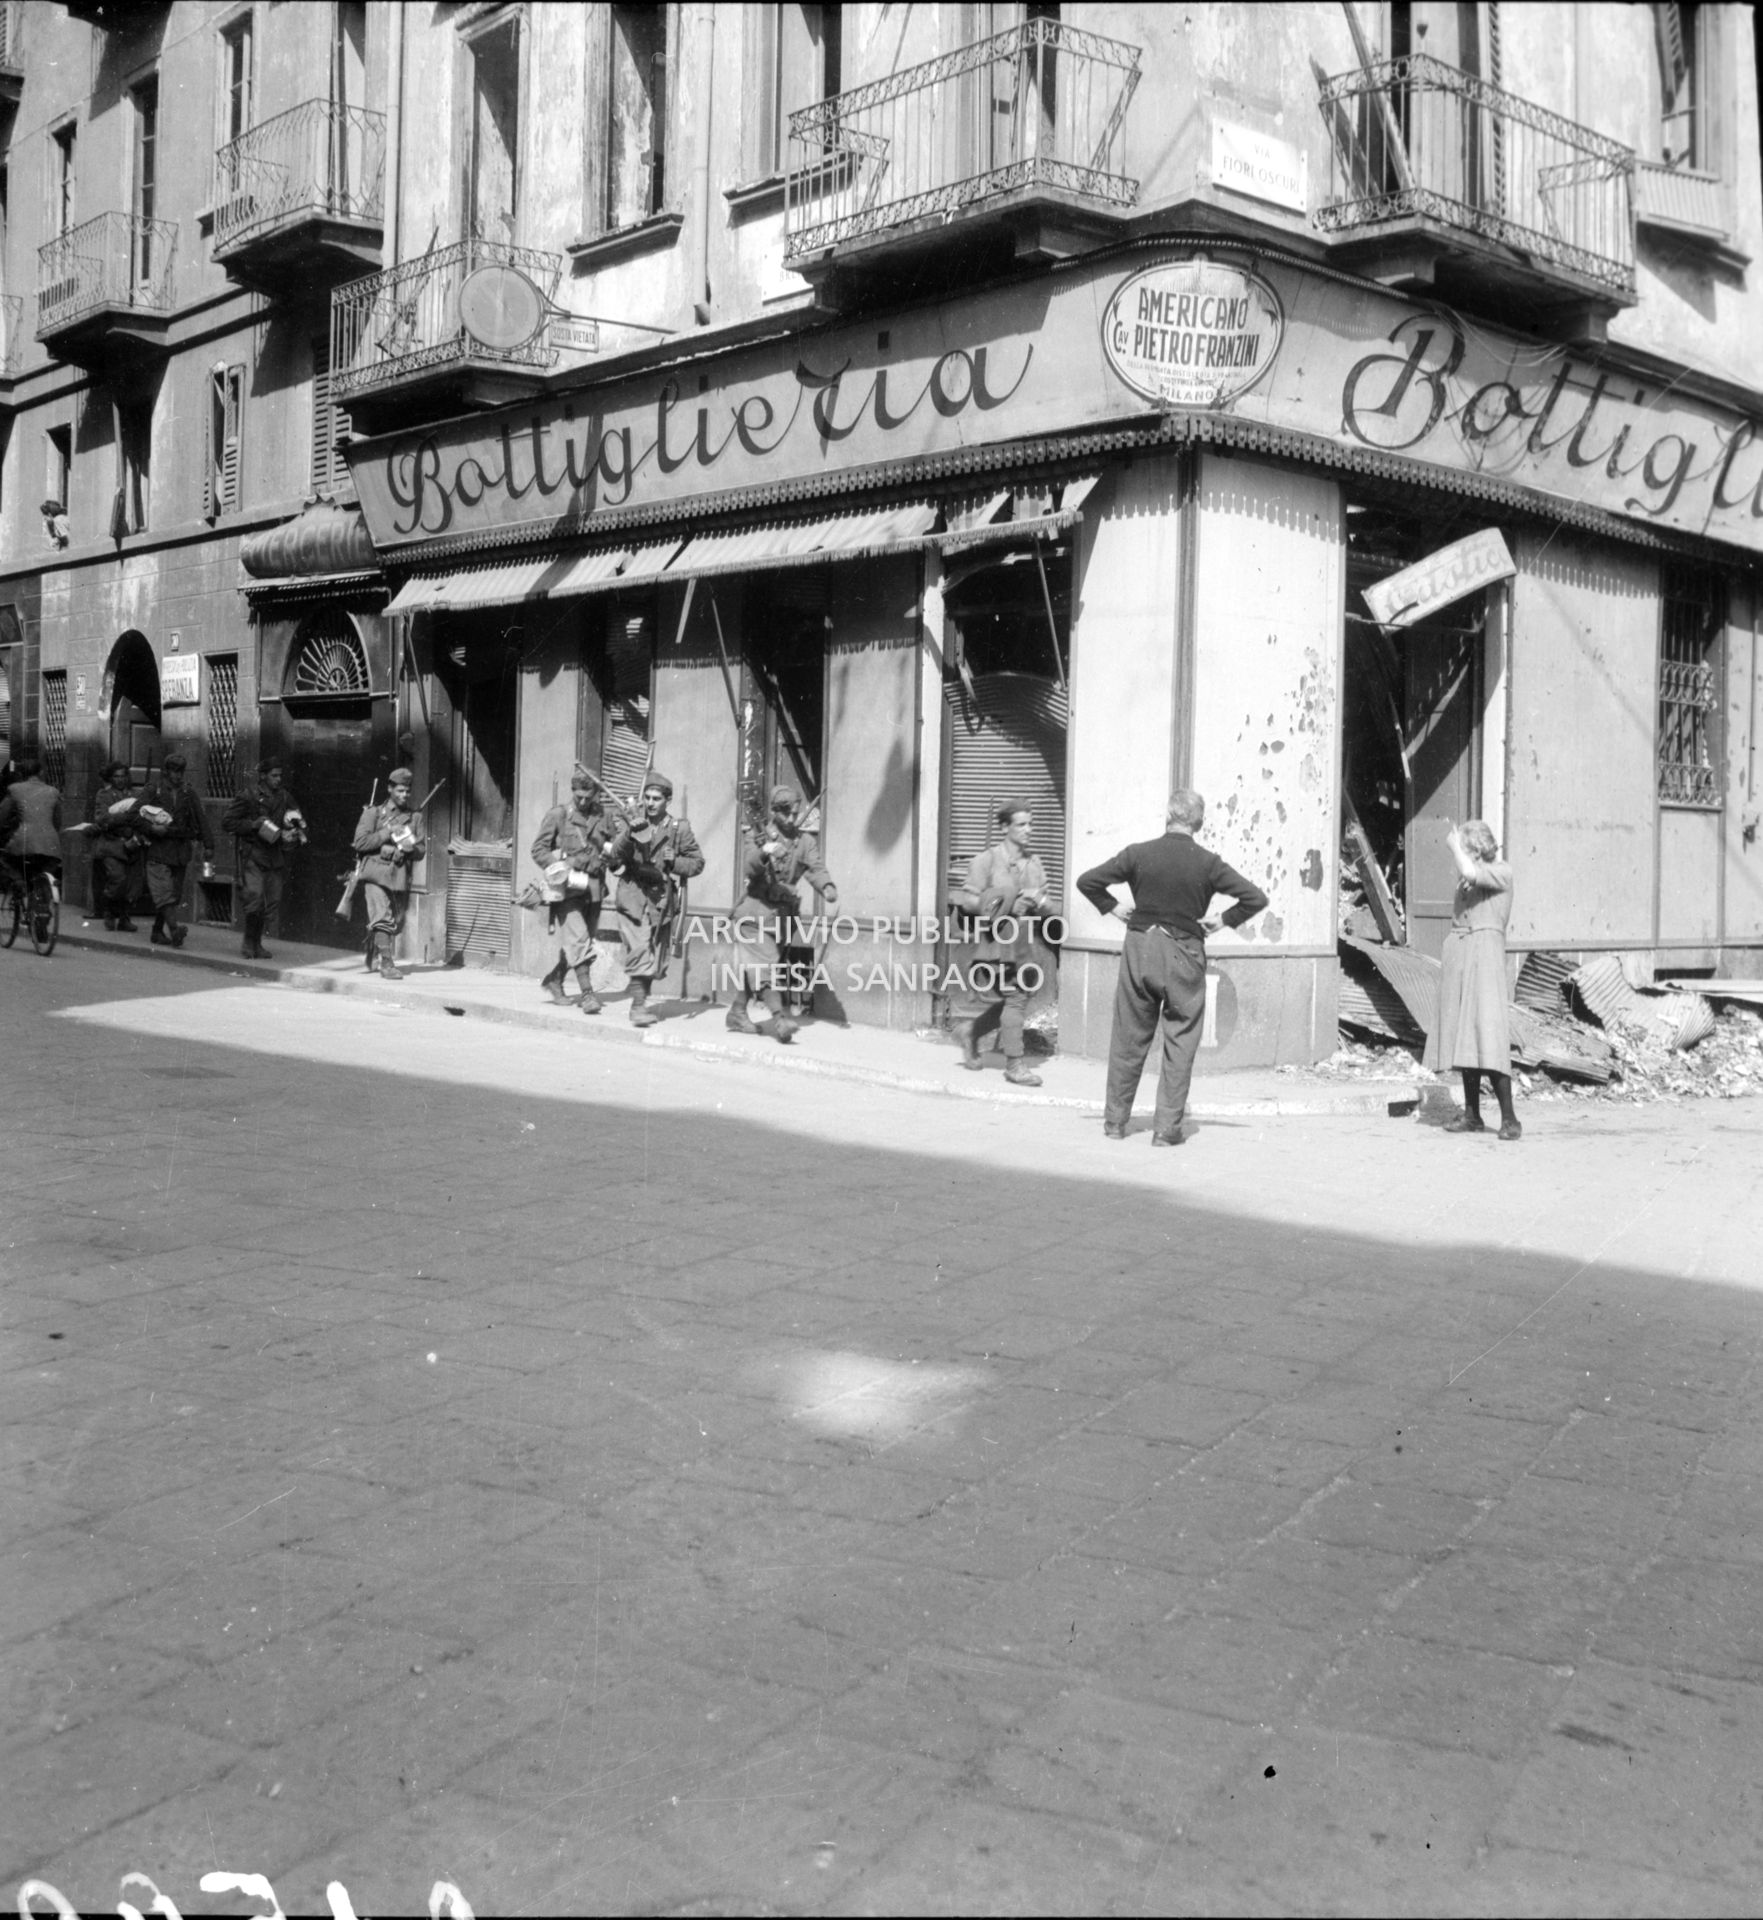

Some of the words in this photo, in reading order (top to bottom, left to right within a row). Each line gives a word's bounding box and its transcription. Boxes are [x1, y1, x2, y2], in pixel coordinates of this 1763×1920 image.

[1254, 143, 1271, 159] VIA
[1223, 155, 1255, 178] FIORI
[1259, 167, 1300, 193] OSCURI
[1138, 287, 1249, 330] AMERICANO
[552, 326, 572, 342] SOSTA
[572, 330, 596, 345] VIETATA
[1134, 324, 1193, 366] PIETRO
[1194, 333, 1260, 368] FRANZINI
[1160, 384, 1214, 401] MILANO
[387, 331, 1034, 532] Bottiglieria
